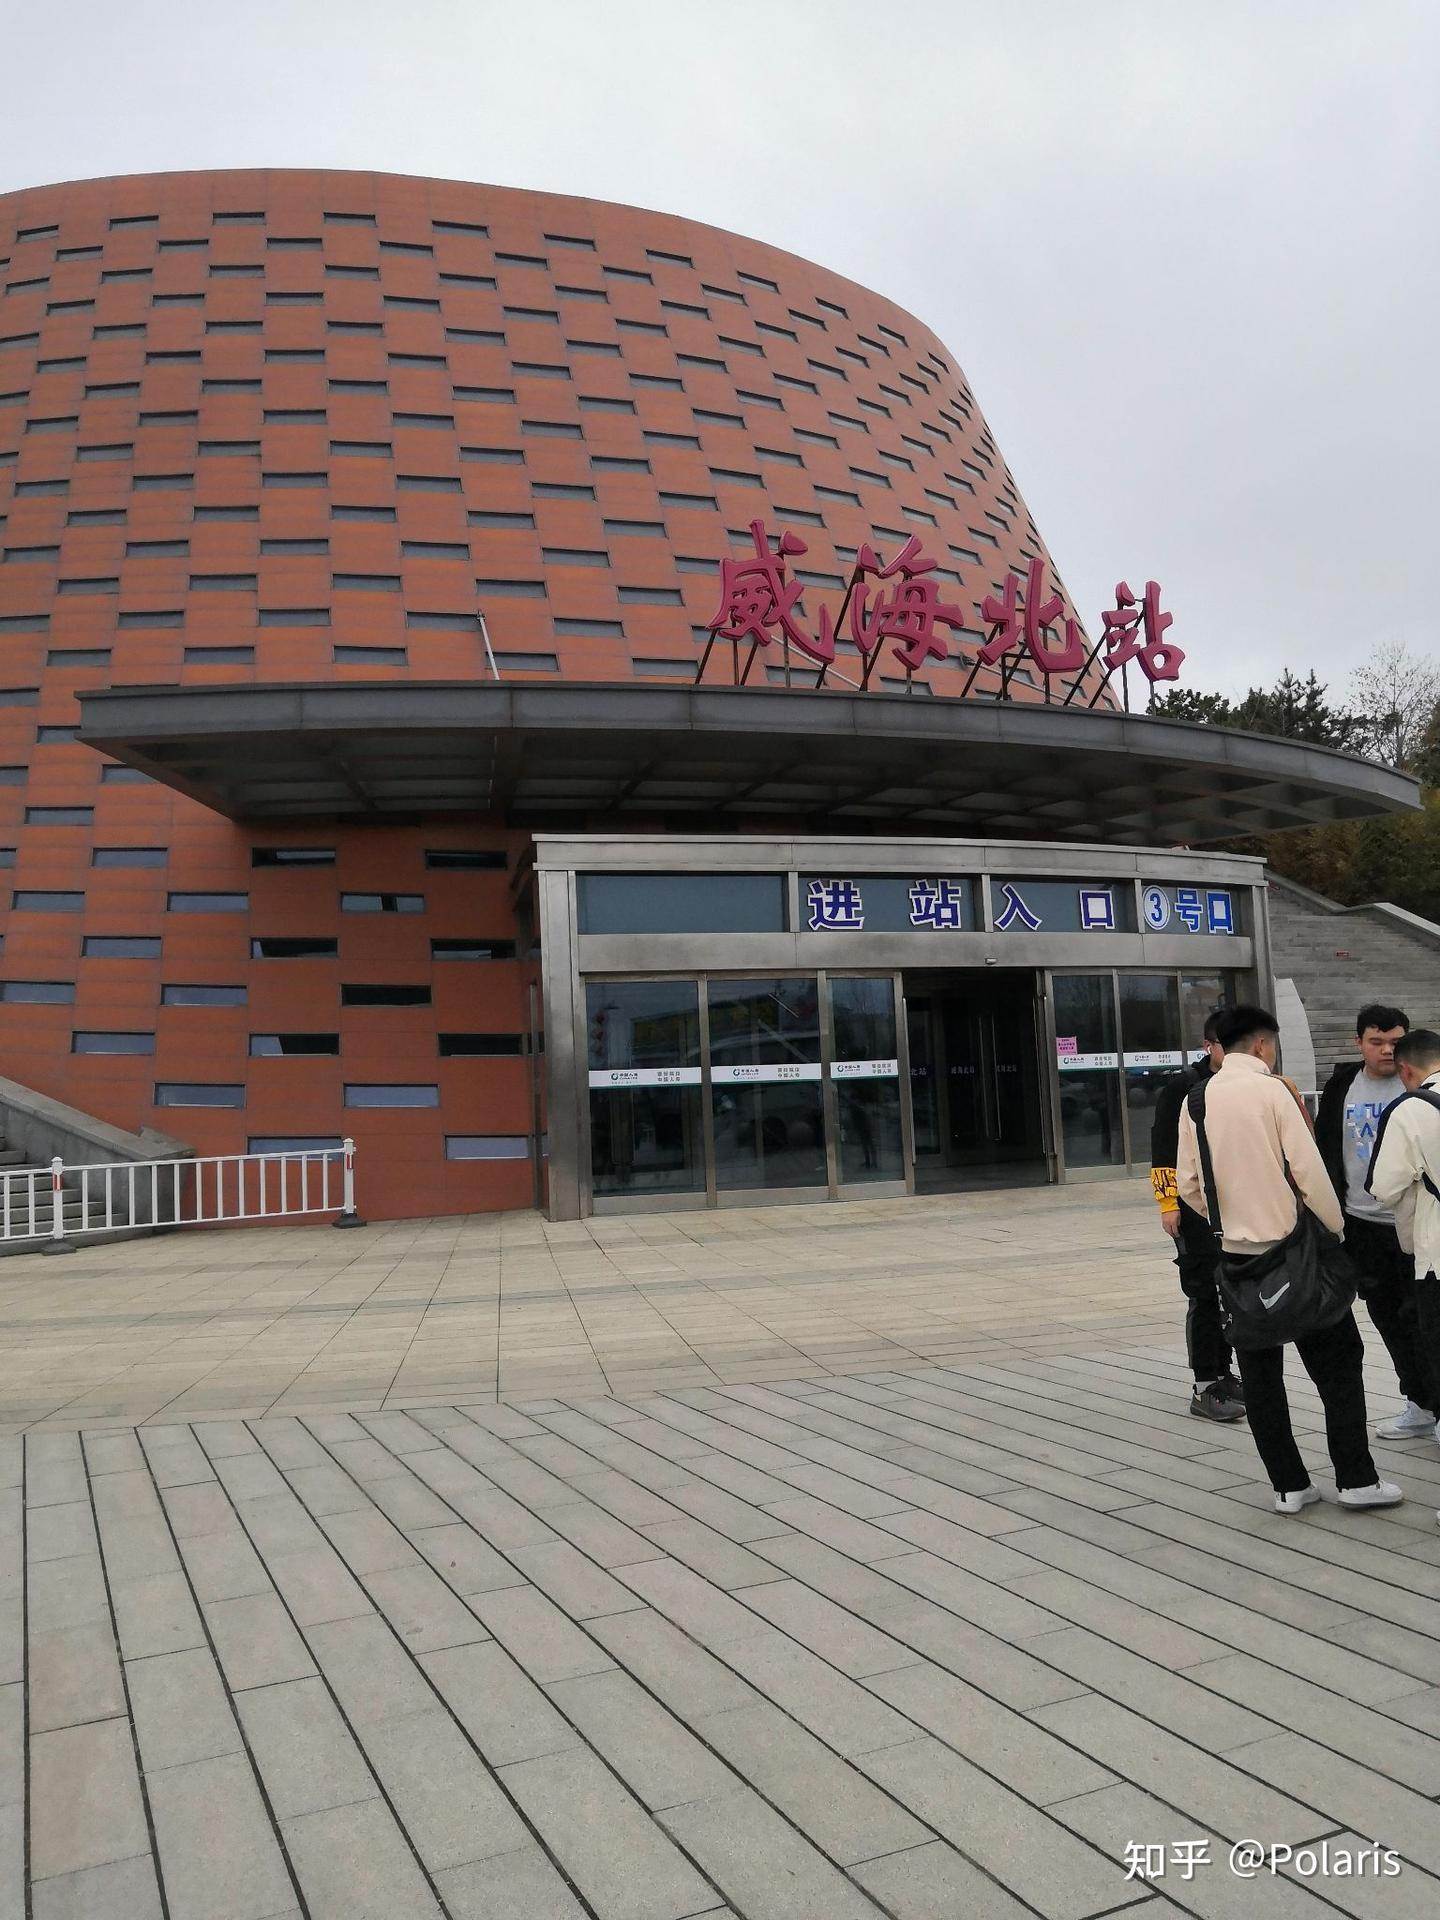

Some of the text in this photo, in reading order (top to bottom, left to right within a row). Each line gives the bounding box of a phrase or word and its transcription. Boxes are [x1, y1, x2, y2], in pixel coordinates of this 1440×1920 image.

[706, 519, 1186, 682] 威海北站
[808, 879, 1115, 931] 进站入口
[1346, 1103, 1384, 1119] FUTU
